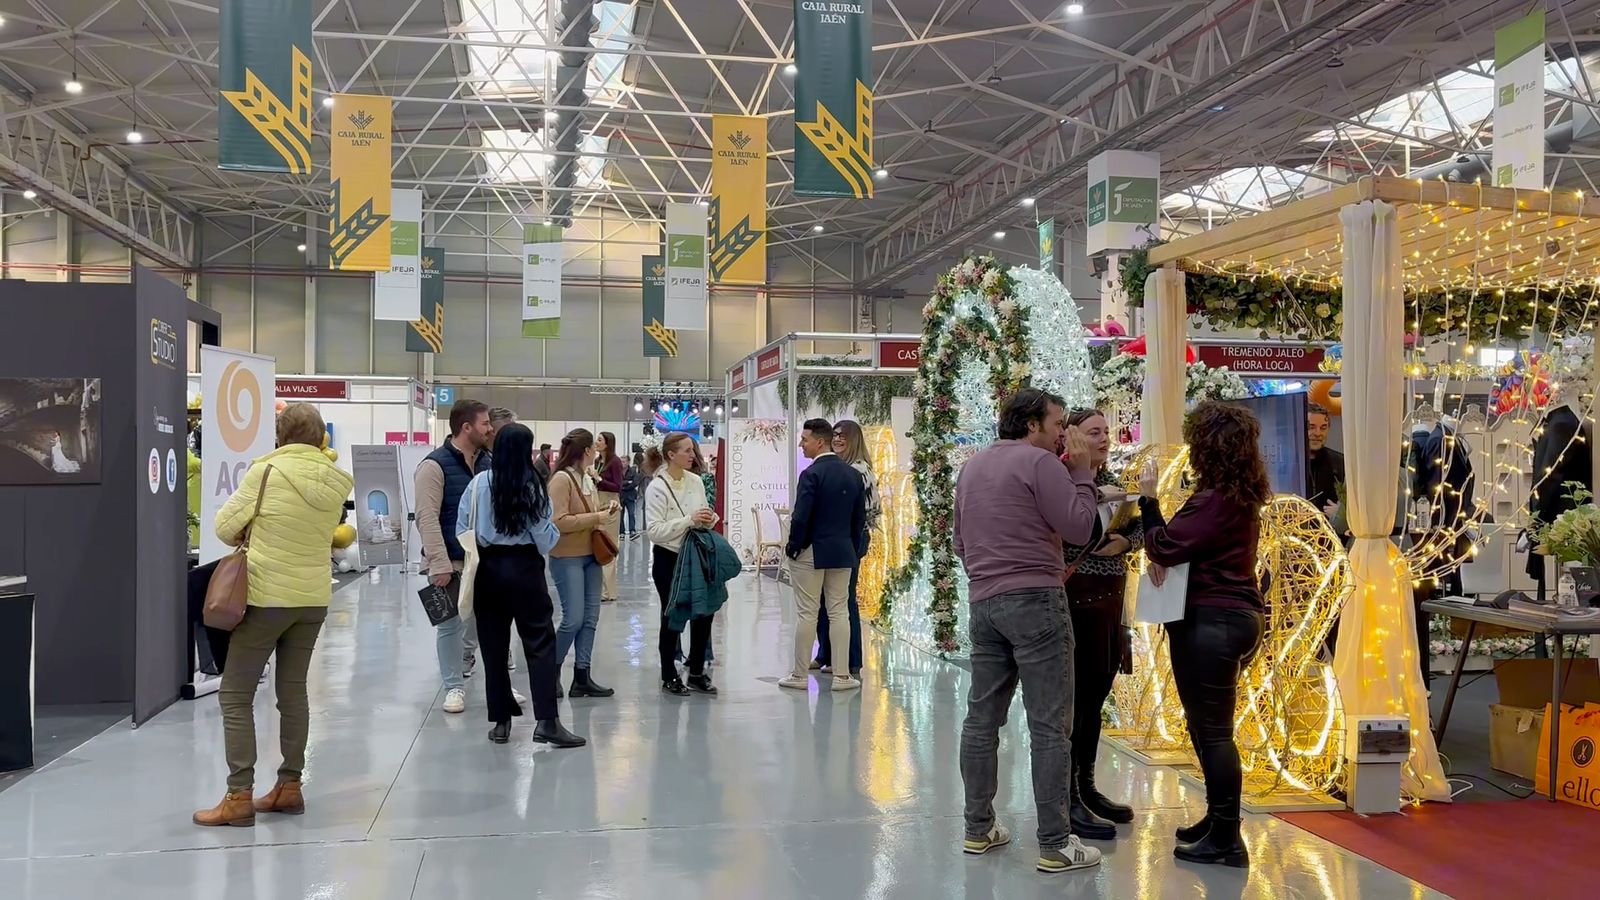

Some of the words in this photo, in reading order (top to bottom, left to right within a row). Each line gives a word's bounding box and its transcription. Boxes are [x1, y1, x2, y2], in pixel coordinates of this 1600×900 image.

[802, 1, 827, 11] CAJA
[829, 3, 864, 14] RURAL
[679, 277, 701, 285] IFEJA
[1221, 347, 1273, 357] TREMENDO
[1275, 348, 1304, 358] JALEO
[1233, 360, 1264, 371] (HORA
[1266, 361, 1294, 372] LOCA)
[292, 385, 318, 393] VIAJES
[439, 388, 449, 402] 5
[732, 445, 743, 486] BODAS
[734, 488, 742, 497] Y
[731, 499, 743, 550] EVENTOS
